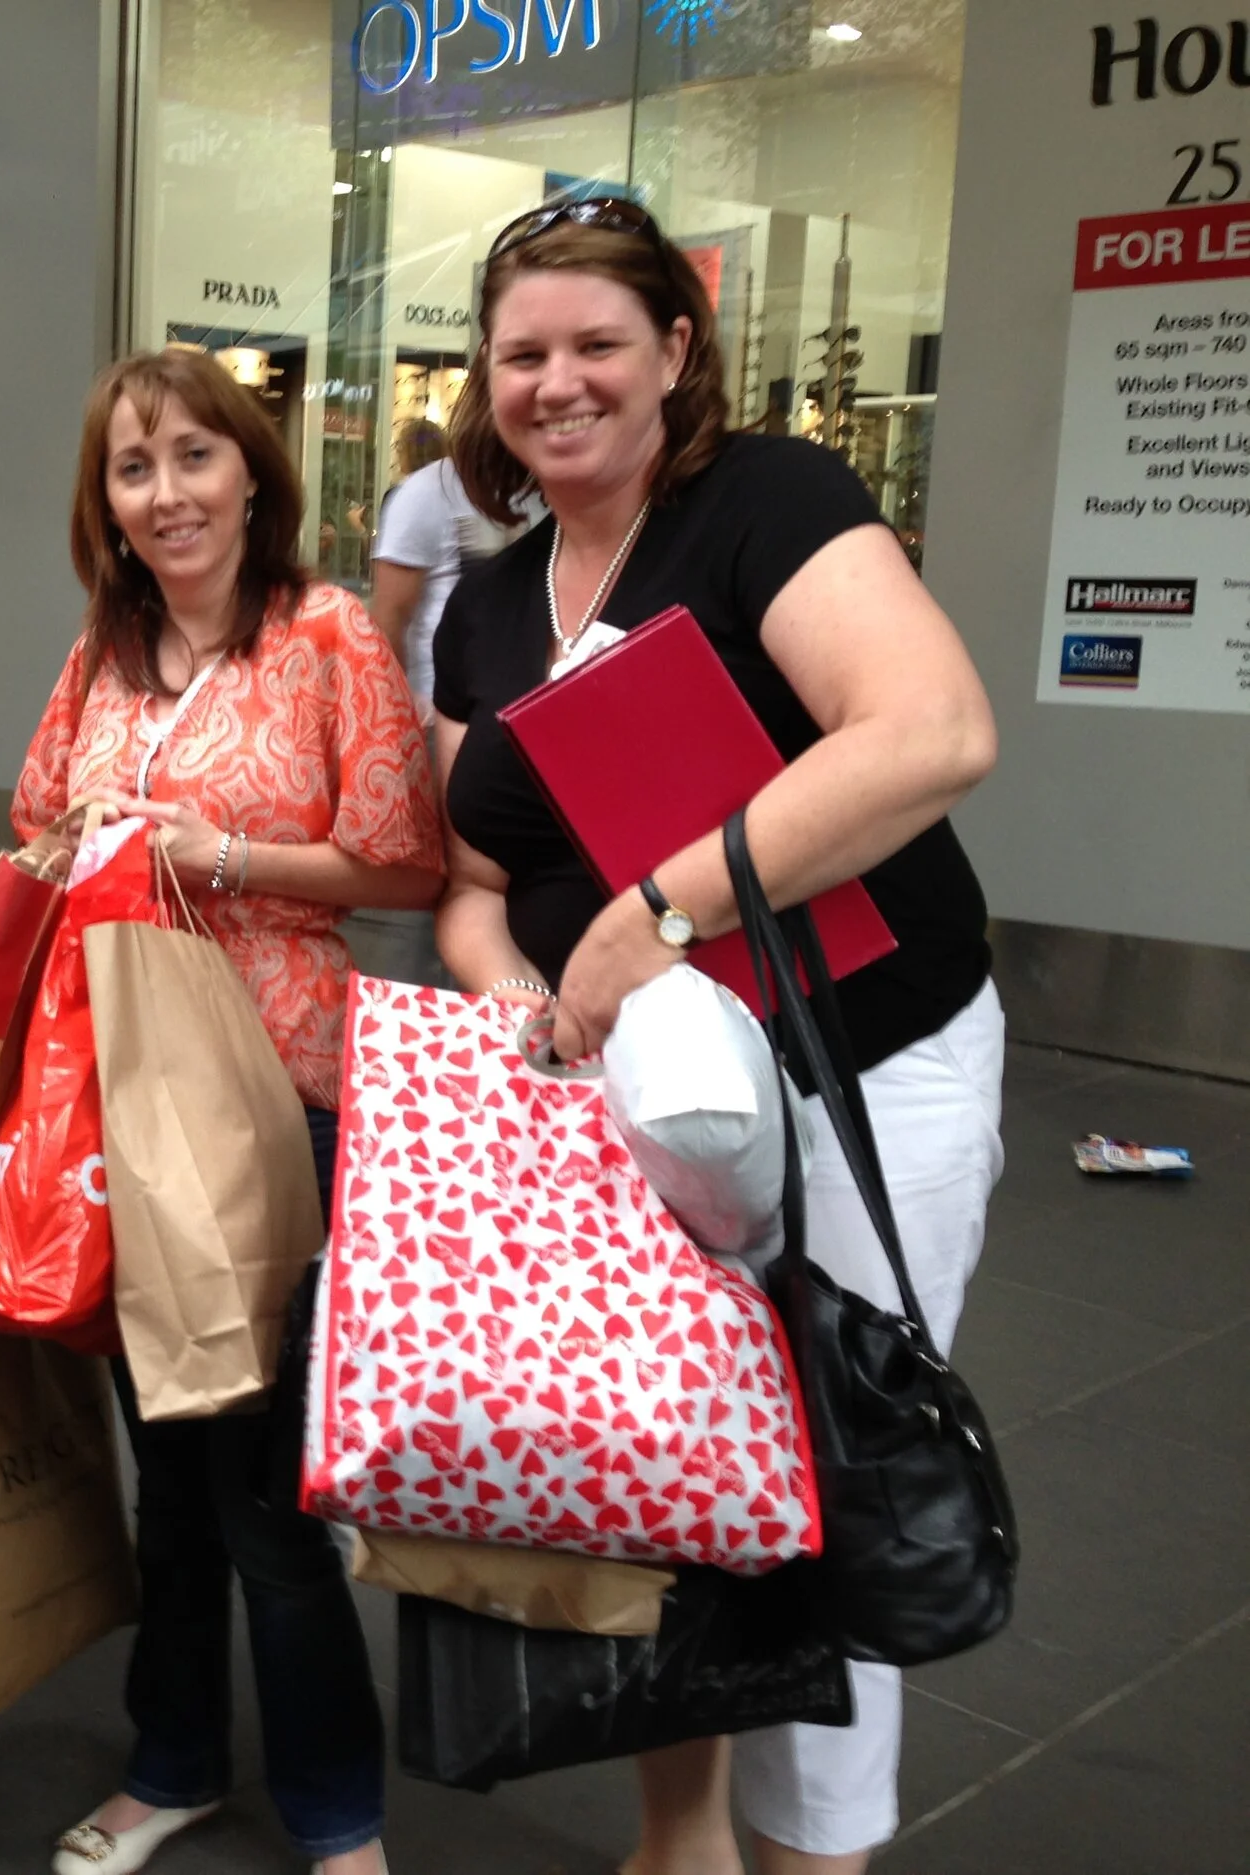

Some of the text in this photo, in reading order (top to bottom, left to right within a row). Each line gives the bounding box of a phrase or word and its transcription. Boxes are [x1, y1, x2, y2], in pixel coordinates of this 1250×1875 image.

[353, 0, 601, 95] OPSM
[1165, 138, 1242, 206] 25
[1093, 220, 1250, 272] FOR LE
[203, 279, 281, 309] PRADA
[1153, 309, 1250, 333] Areas fro
[1144, 341, 1188, 363] sqm
[1210, 334, 1247, 355] 740
[1116, 372, 1248, 396] Whole Floors
[1126, 399, 1206, 421] Existing
[1126, 433, 1218, 455] Excellent
[1145, 458, 1250, 479] and Views
[1085, 495, 1147, 518] Ready
[1152, 496, 1171, 514] to
[1070, 582, 1191, 609] Hallmarc
[1069, 641, 1134, 662] Colliers
